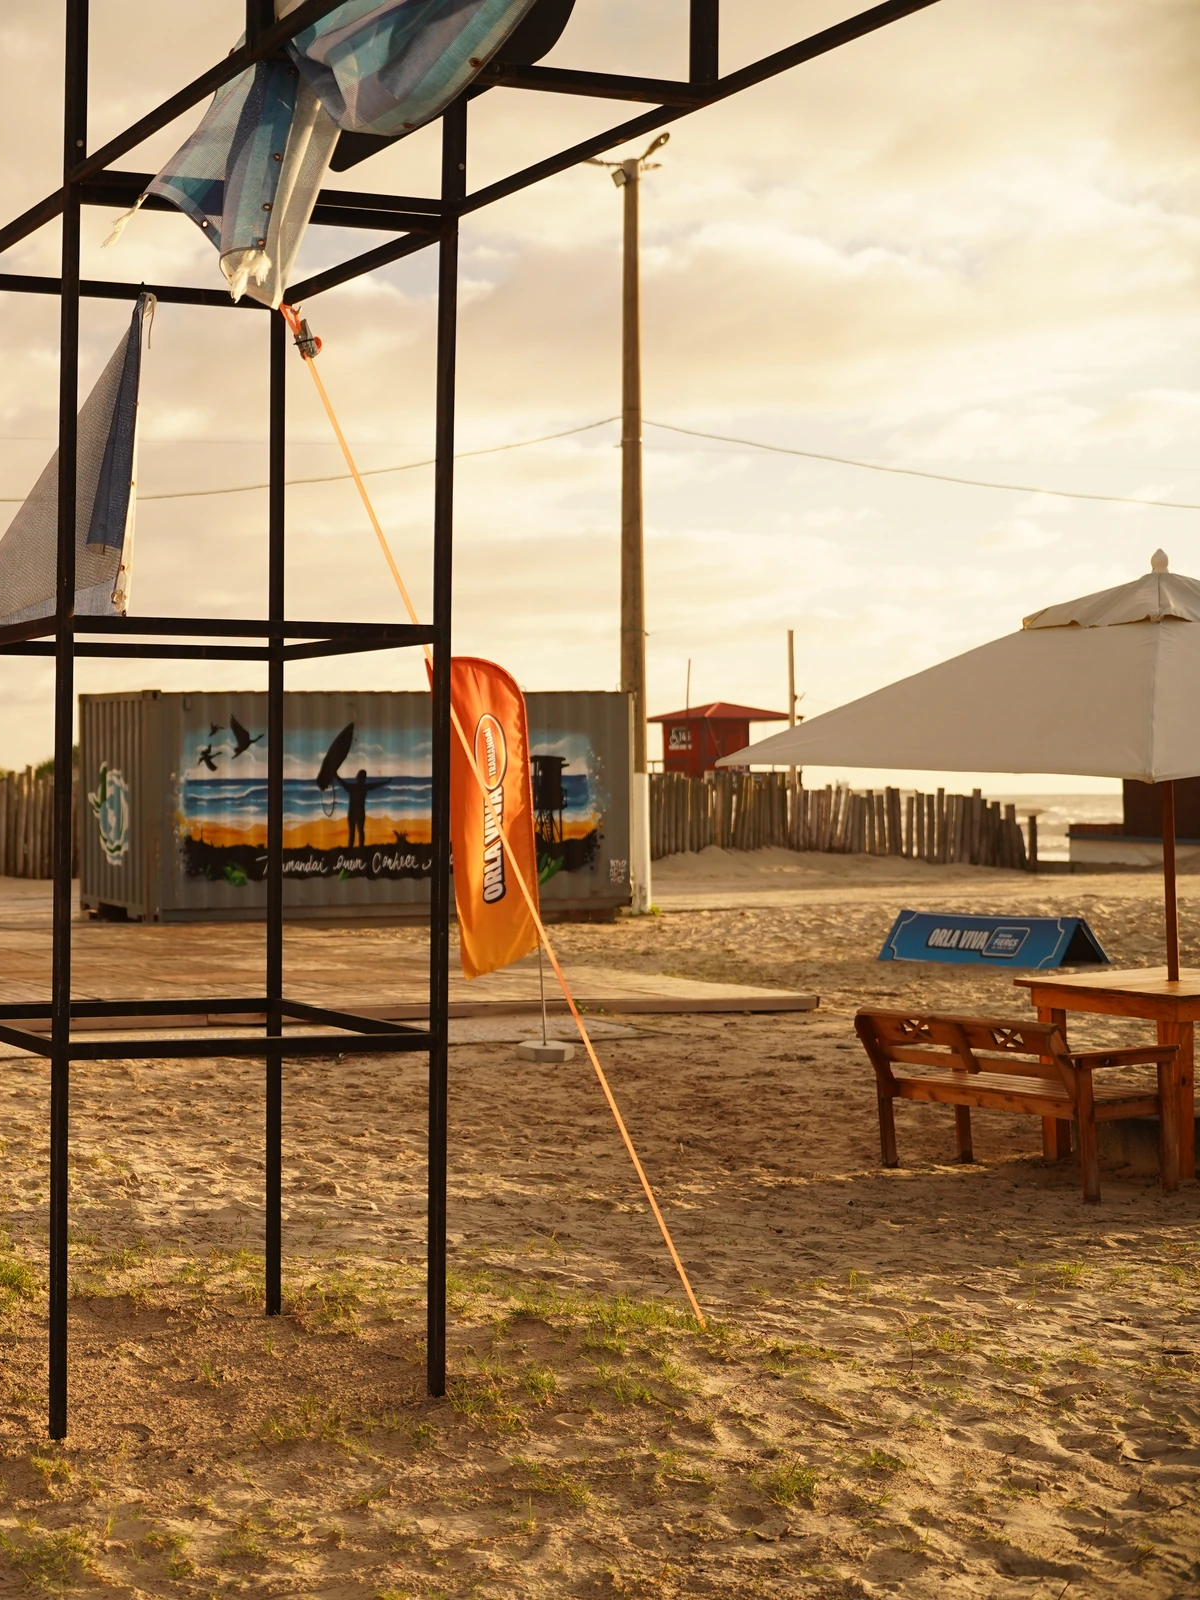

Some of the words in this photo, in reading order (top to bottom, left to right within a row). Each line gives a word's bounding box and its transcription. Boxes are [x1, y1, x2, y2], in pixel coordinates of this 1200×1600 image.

[484, 840, 503, 902] ORLA
[928, 928, 960, 947] ORLA
[958, 930, 989, 949] VIVA
